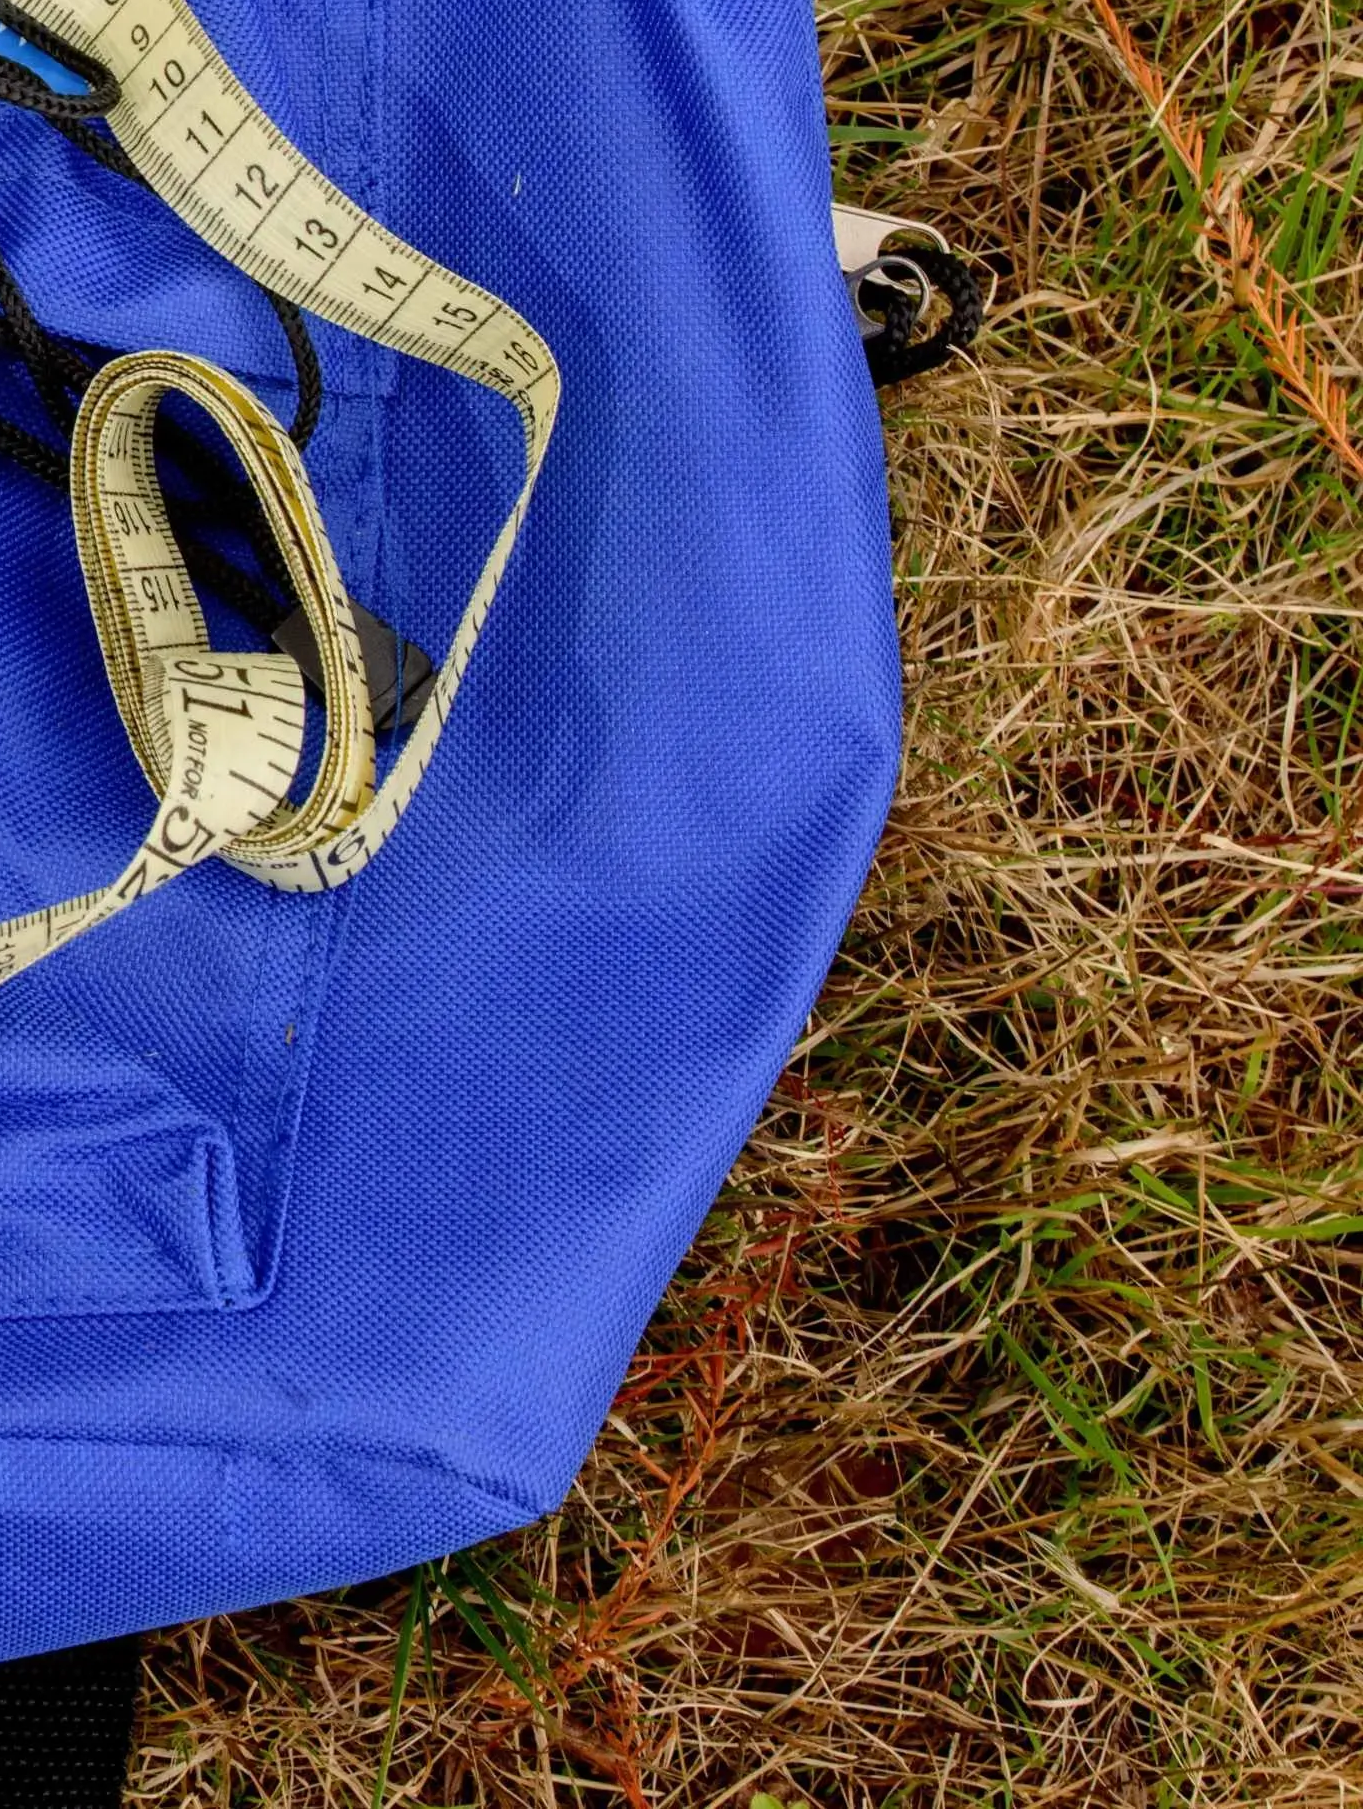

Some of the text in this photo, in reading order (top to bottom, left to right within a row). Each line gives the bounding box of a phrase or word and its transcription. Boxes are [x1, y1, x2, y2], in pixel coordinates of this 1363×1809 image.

[149, 58, 187, 102] 10
[185, 109, 225, 154] 11
[234, 163, 280, 211] 12
[294, 218, 339, 262] 13
[361, 265, 408, 302] 14
[178, 718, 209, 800] NOT FOR
